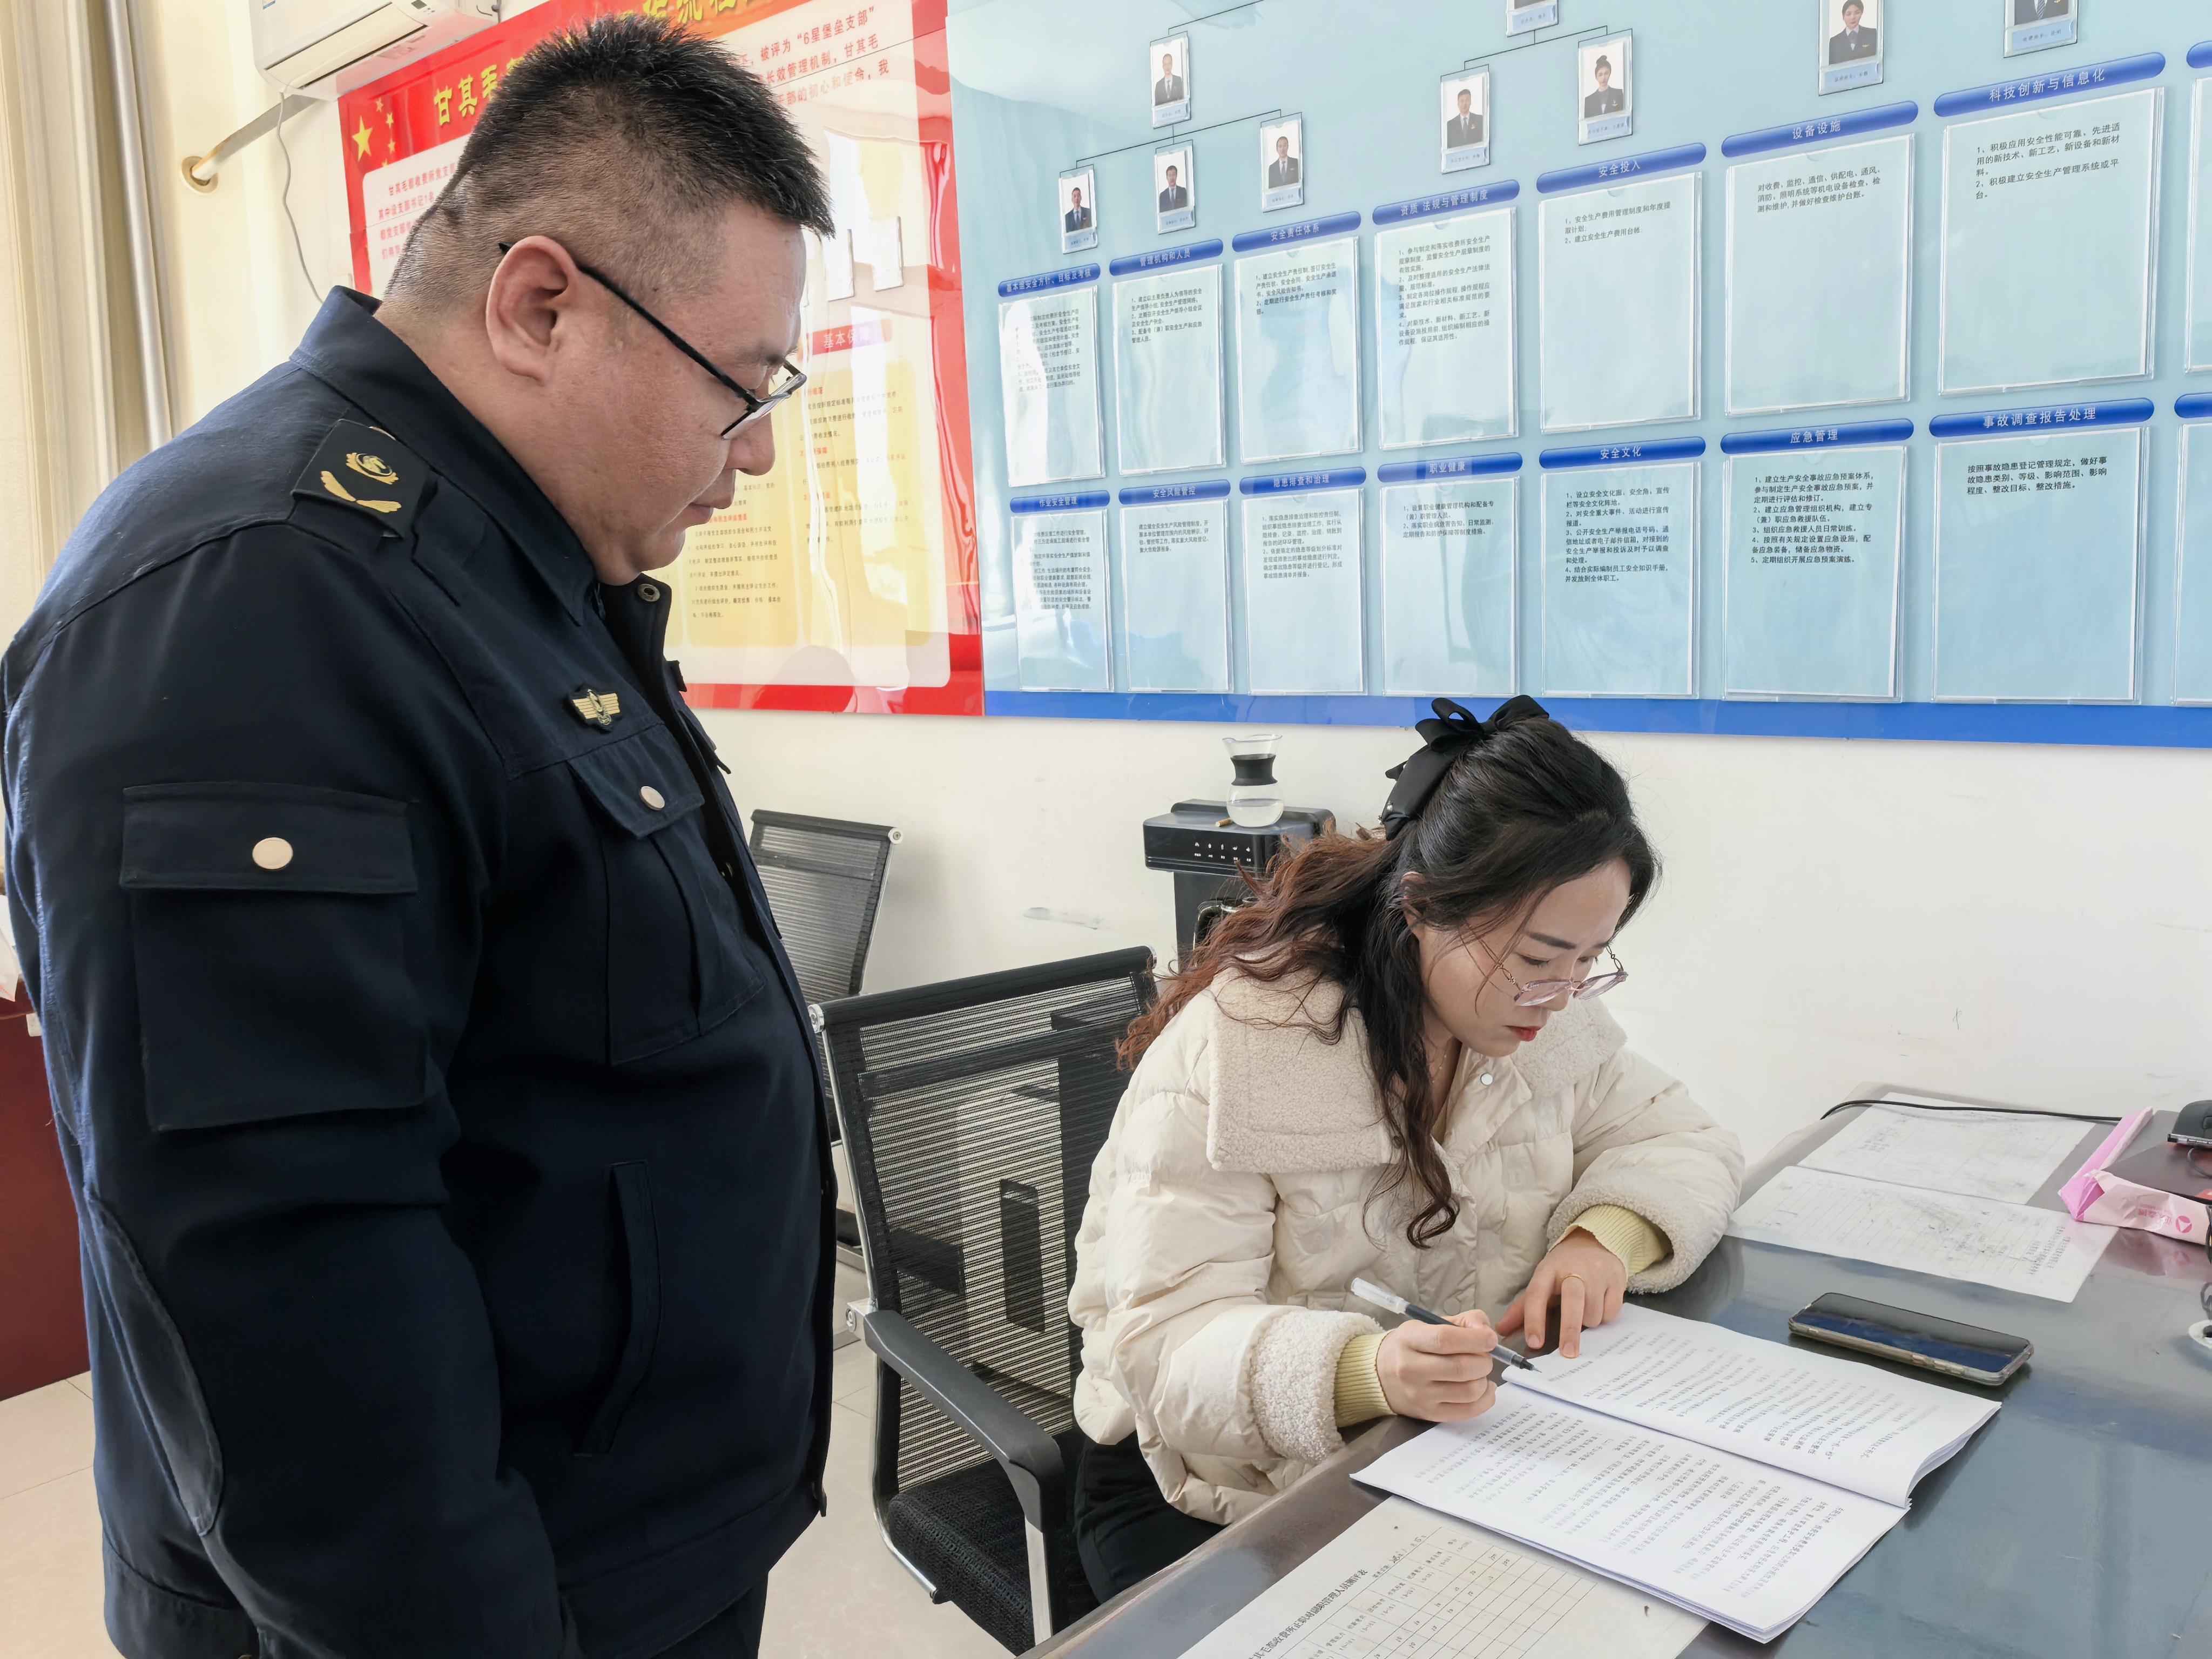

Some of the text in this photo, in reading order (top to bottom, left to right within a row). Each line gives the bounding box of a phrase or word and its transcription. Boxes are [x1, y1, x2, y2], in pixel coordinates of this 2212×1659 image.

[1990, 68, 2105, 102] 科技创新与信息化
[1792, 120, 1841, 139] 设备设施
[1599, 160, 1640, 178] 安全投入
[1271, 222, 1320, 241] 安全责任体系
[1140, 248, 1190, 267] 管理机构和人员
[824, 327, 869, 348] 基本保障
[1983, 407, 2096, 429] 事故调查报告处理
[1790, 429, 1838, 444] 应急管理
[1600, 446, 1641, 460] 安全文化
[1429, 461, 1466, 474] 职业健康
[1273, 474, 1330, 488] 隐患排查和治理
[1153, 486, 1196, 498] 安全风险管控
[1039, 496, 1077, 507] 作业安全管理
